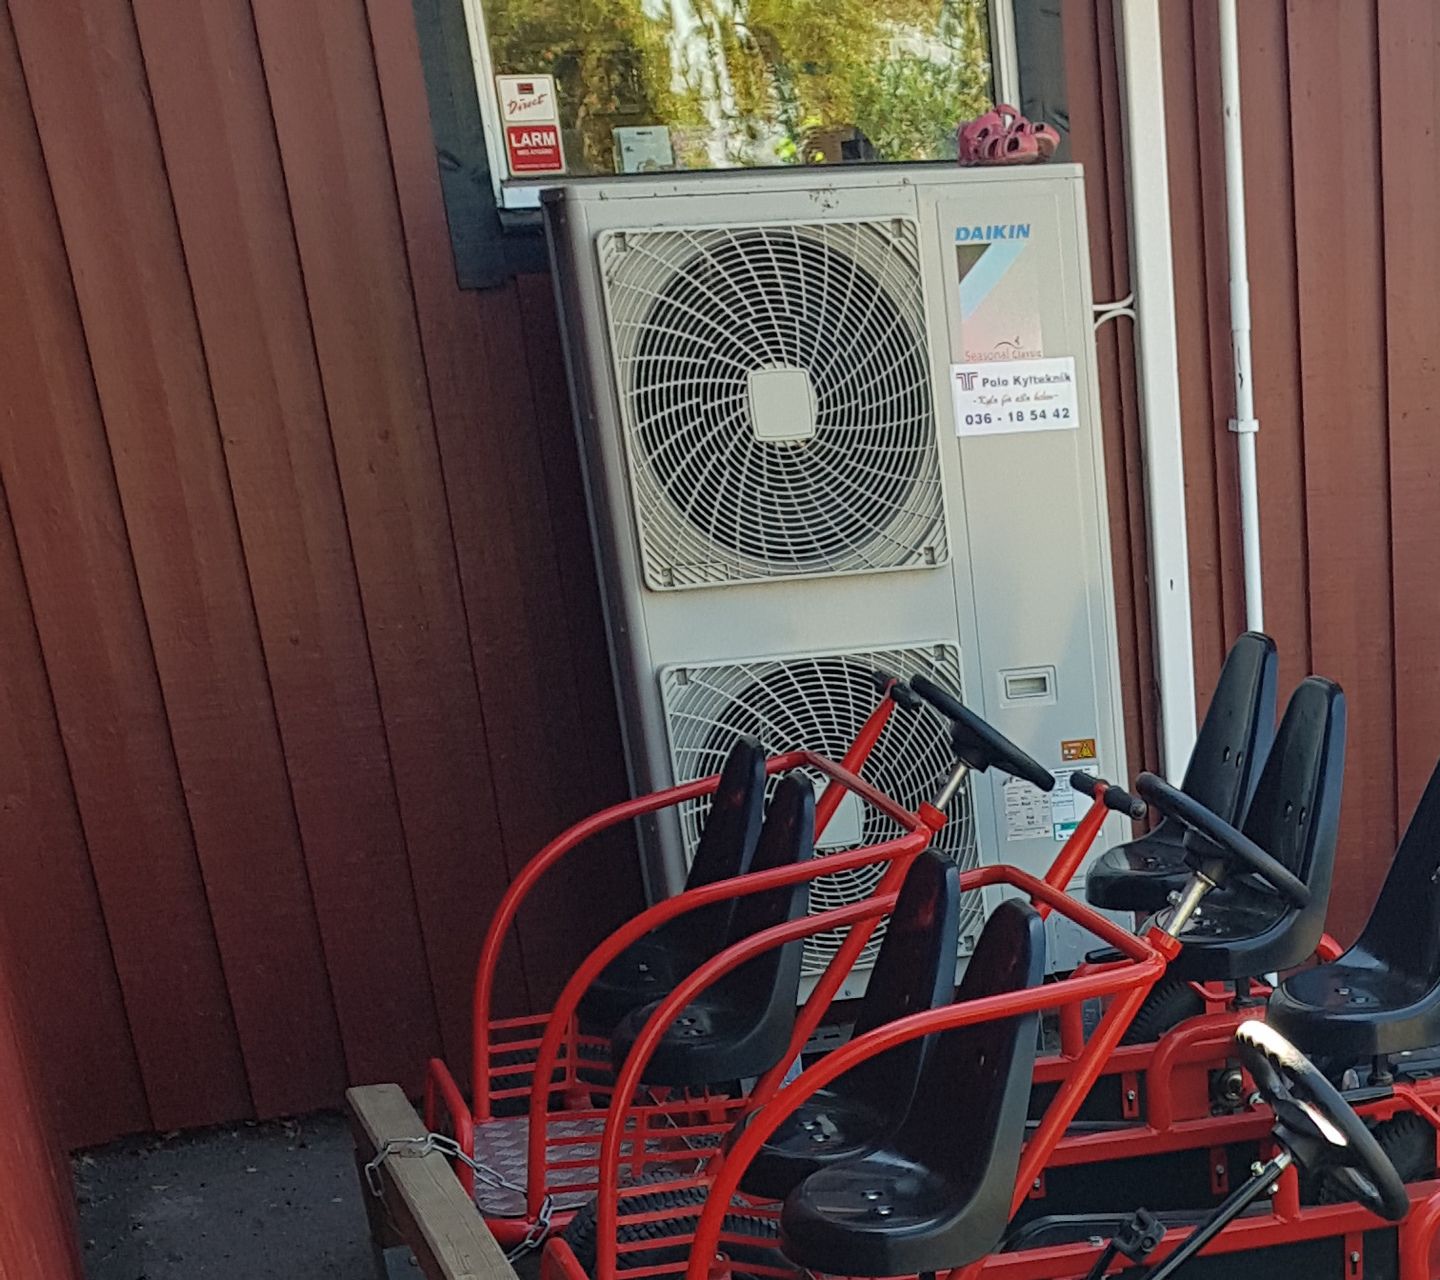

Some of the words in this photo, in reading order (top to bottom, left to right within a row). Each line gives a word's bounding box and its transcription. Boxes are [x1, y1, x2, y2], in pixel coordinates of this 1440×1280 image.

[510, 131, 556, 148] LARM
[955, 224, 1031, 241] DAIKIN
[982, 376, 1009, 388] Polo
[965, 413, 992, 426] 036
[1008, 411, 1024, 423] 18
[1030, 409, 1047, 421] 54
[1053, 407, 1070, 419] 42
